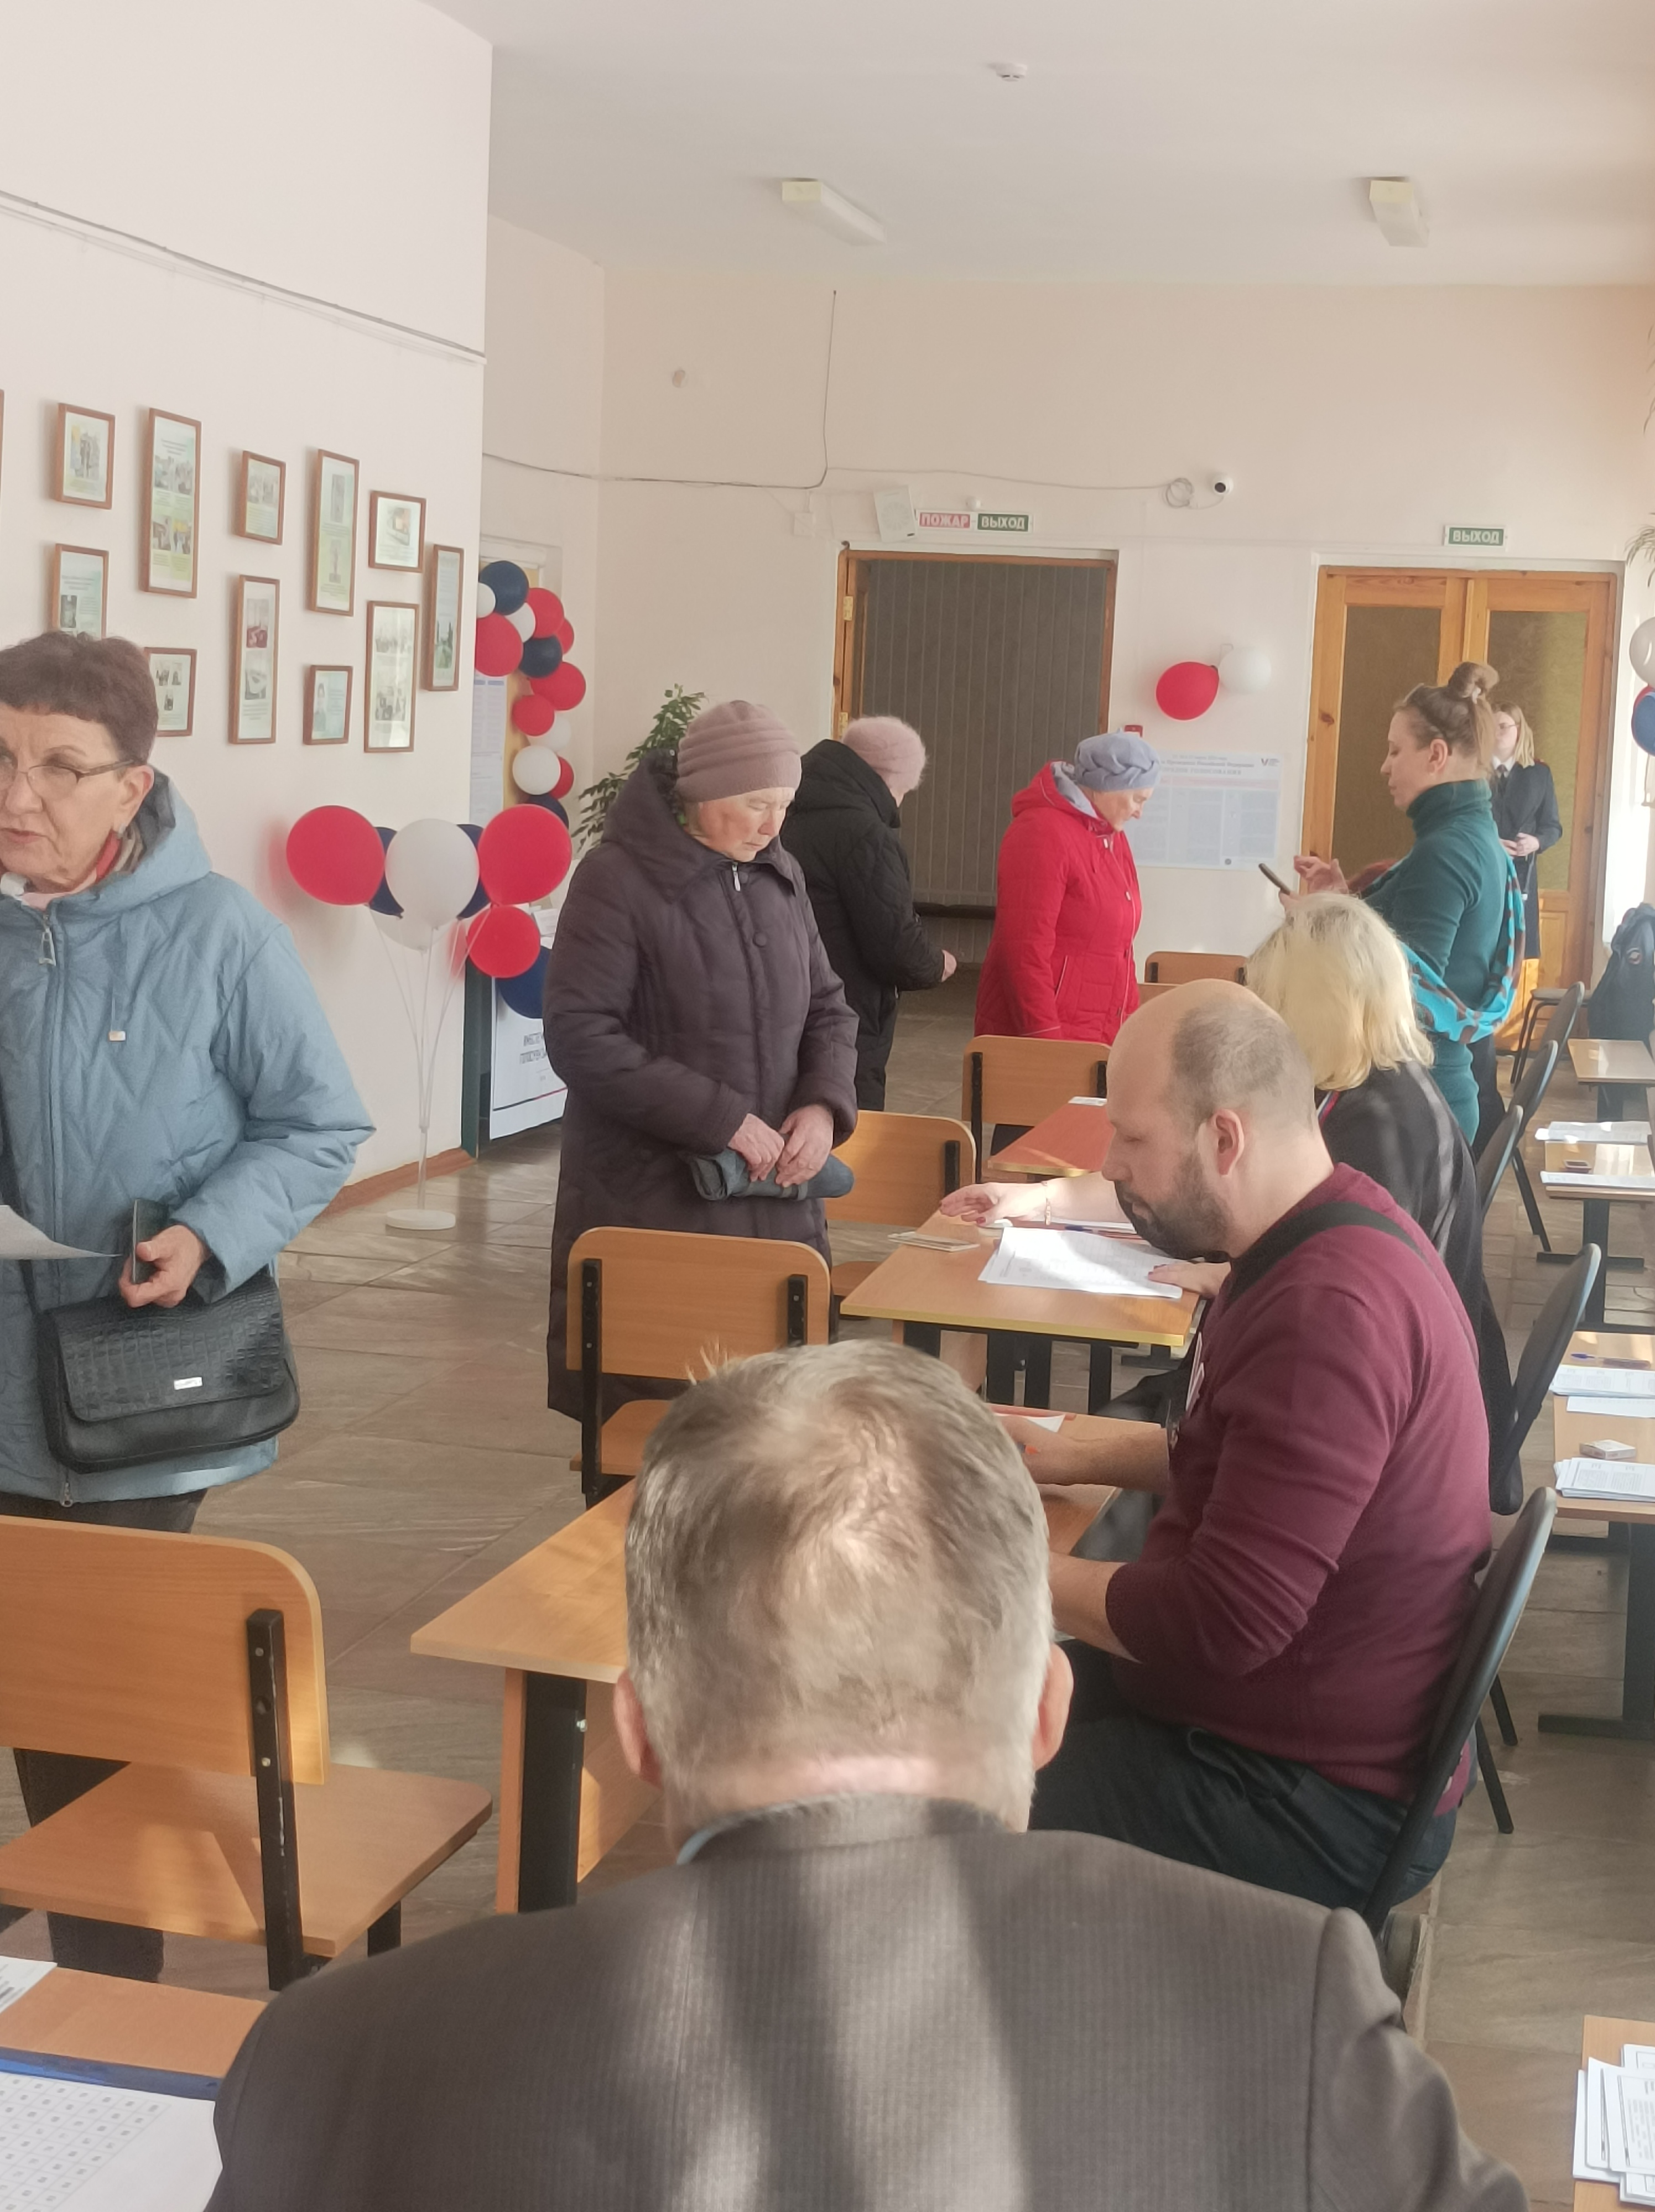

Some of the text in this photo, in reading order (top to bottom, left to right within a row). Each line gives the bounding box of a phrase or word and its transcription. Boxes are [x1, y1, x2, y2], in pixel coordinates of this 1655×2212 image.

[921, 513, 968, 528] ПОЖАР
[981, 515, 1025, 530] ВЫХОД
[1453, 530, 1500, 544] ВЫХОД
